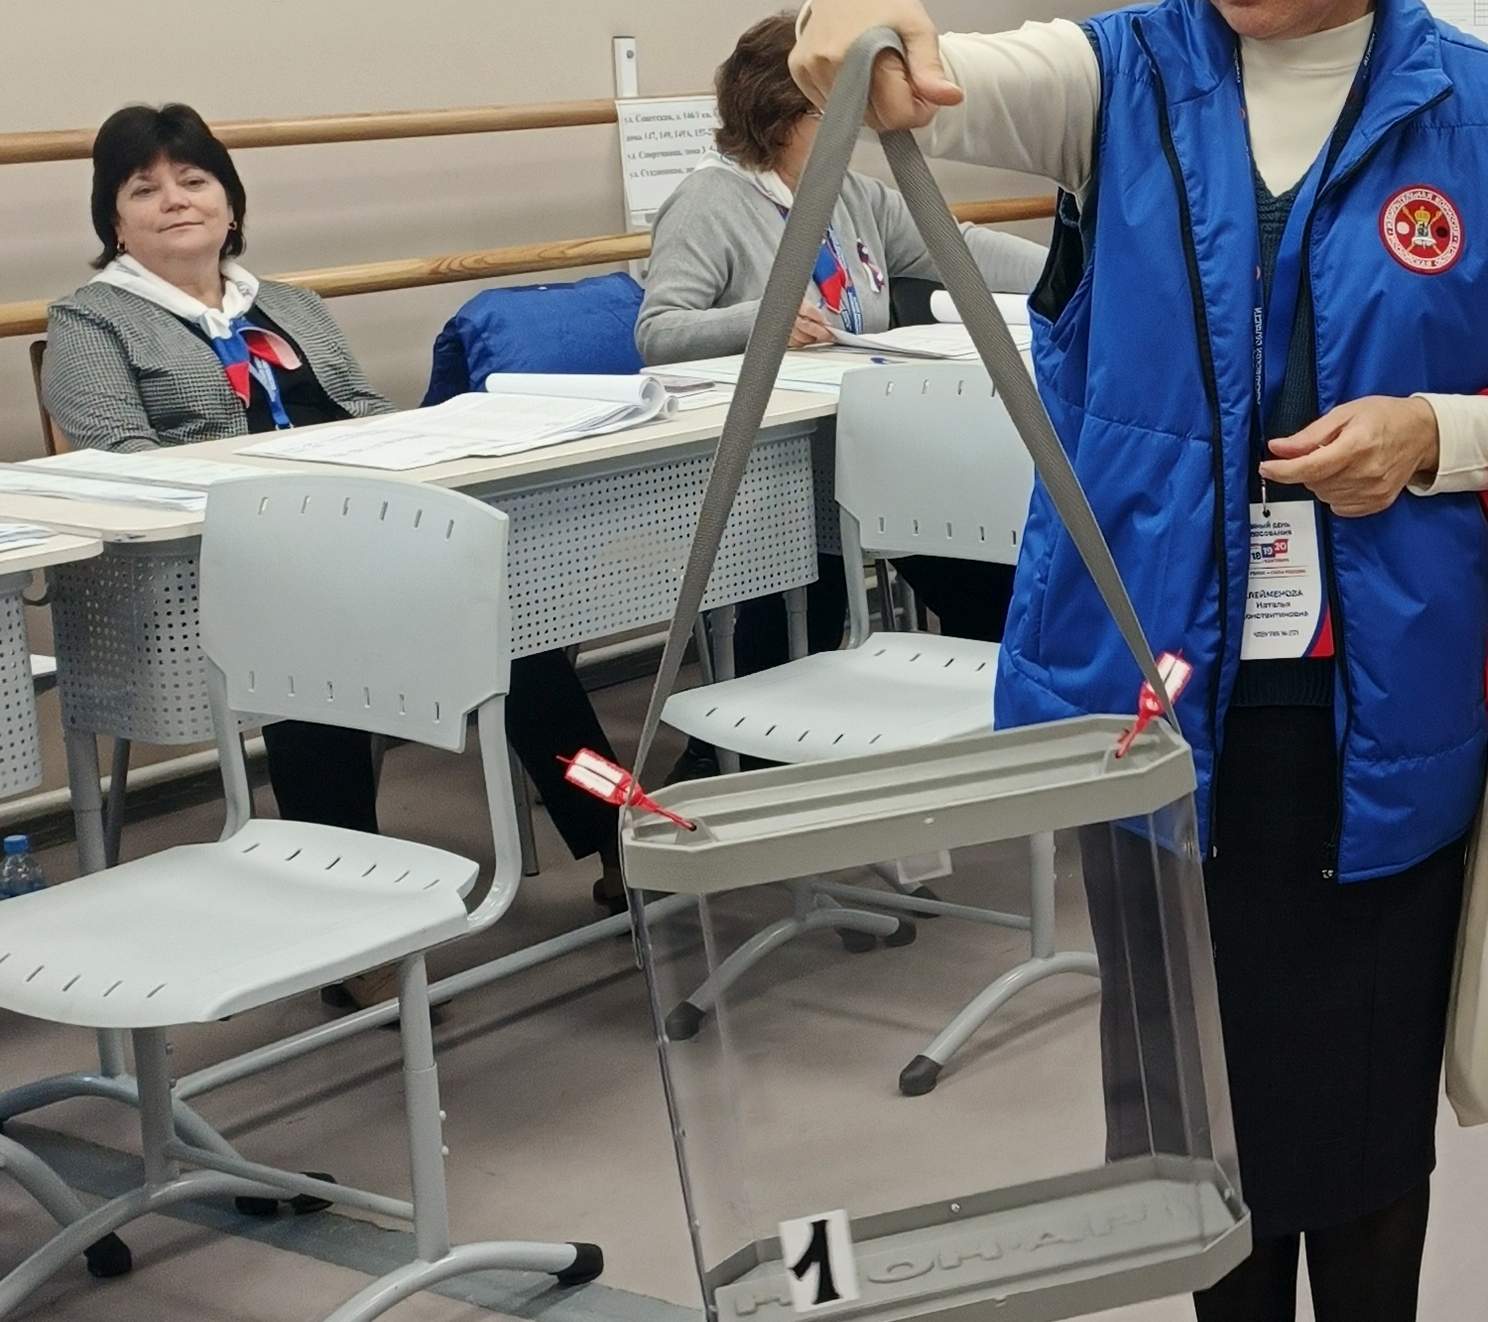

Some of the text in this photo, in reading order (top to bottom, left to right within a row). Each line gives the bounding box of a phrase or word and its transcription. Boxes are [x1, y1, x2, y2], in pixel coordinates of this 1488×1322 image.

[1251, 551, 1262, 561] 18
[1274, 541, 1287, 552] 20
[788, 1218, 842, 1306] 1
